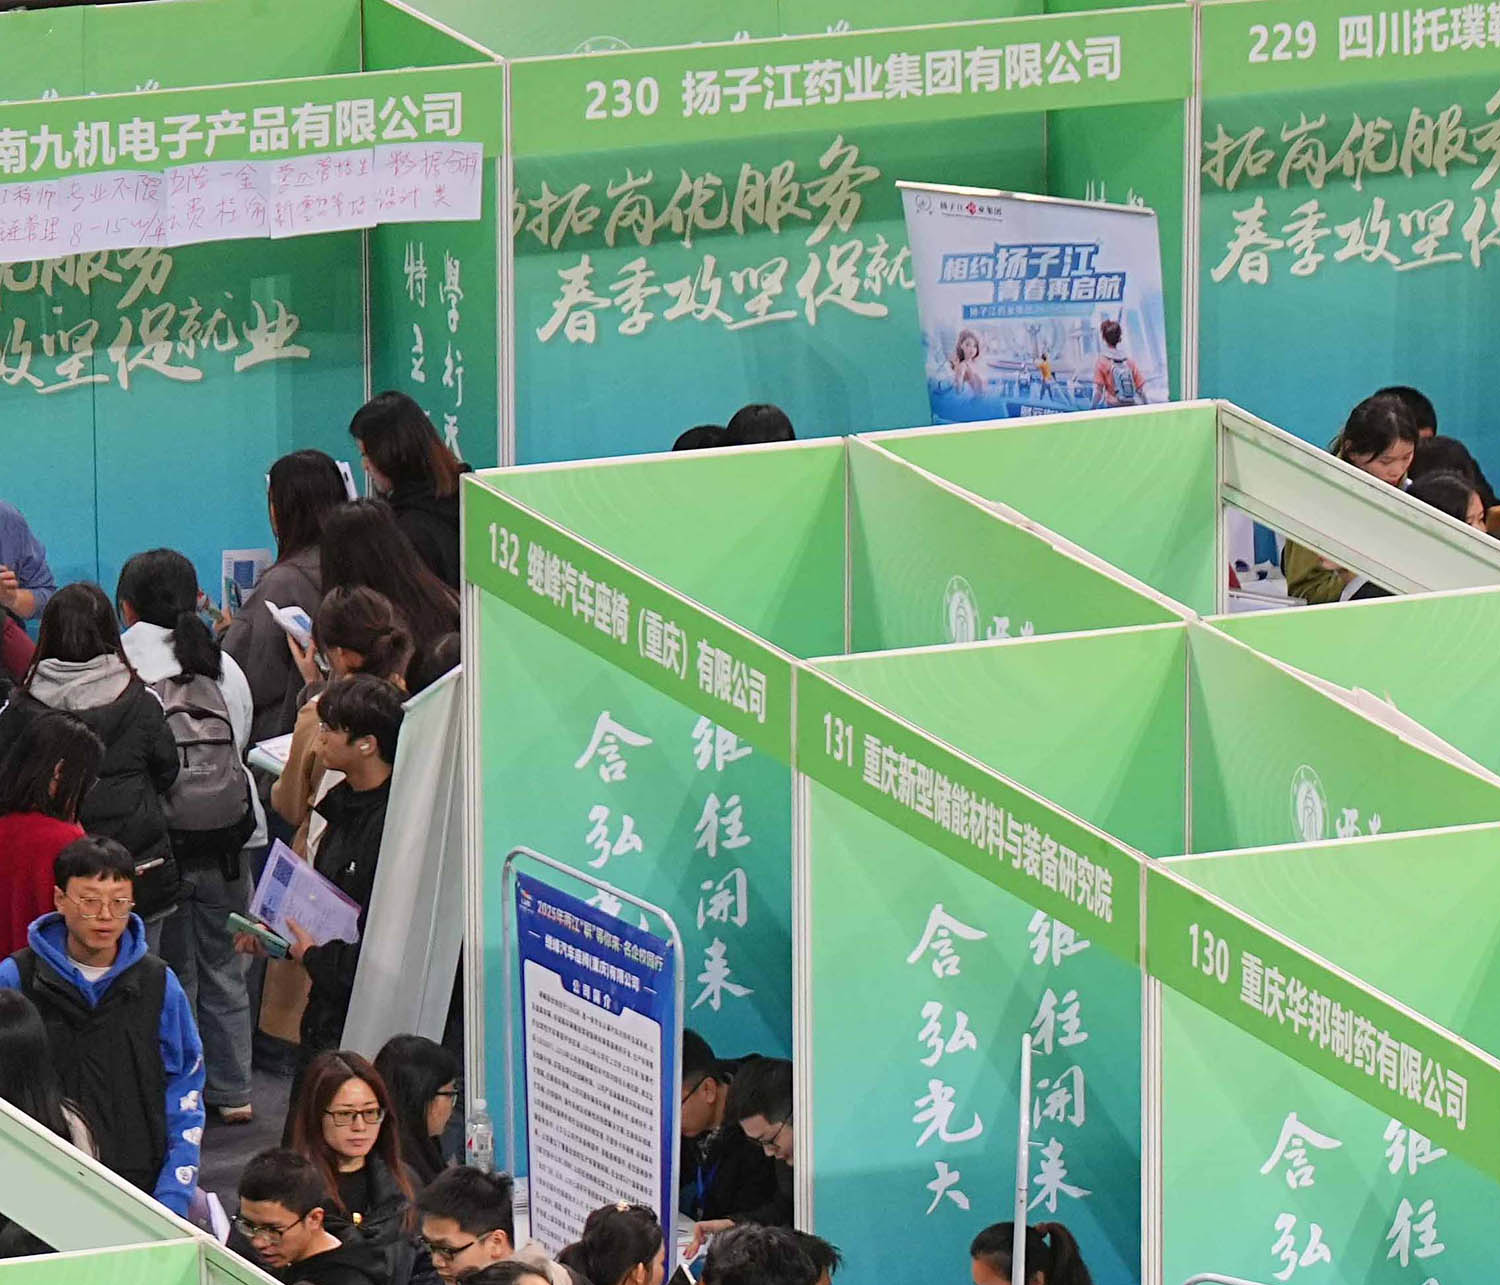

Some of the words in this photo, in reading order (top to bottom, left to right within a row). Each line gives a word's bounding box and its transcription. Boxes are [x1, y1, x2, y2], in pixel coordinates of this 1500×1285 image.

[0, 92, 463, 174] 南九机电子产品有限公司
[585, 79, 660, 119] 230
[682, 36, 1123, 116] 扬子江药业集团有限公司
[1248, 23, 1316, 63] 229
[488, 523, 518, 575] 132
[527, 547, 766, 722] 继峰汽车座椅（重庆）有限公司
[823, 713, 854, 767] 131
[863, 734, 1113, 919] 重庆新型储能材料与装备研究院
[908, 903, 988, 1213] 含弘光大
[1189, 923, 1230, 985] 130
[1239, 956, 1467, 1130] 重庆华邦制药有限公司
